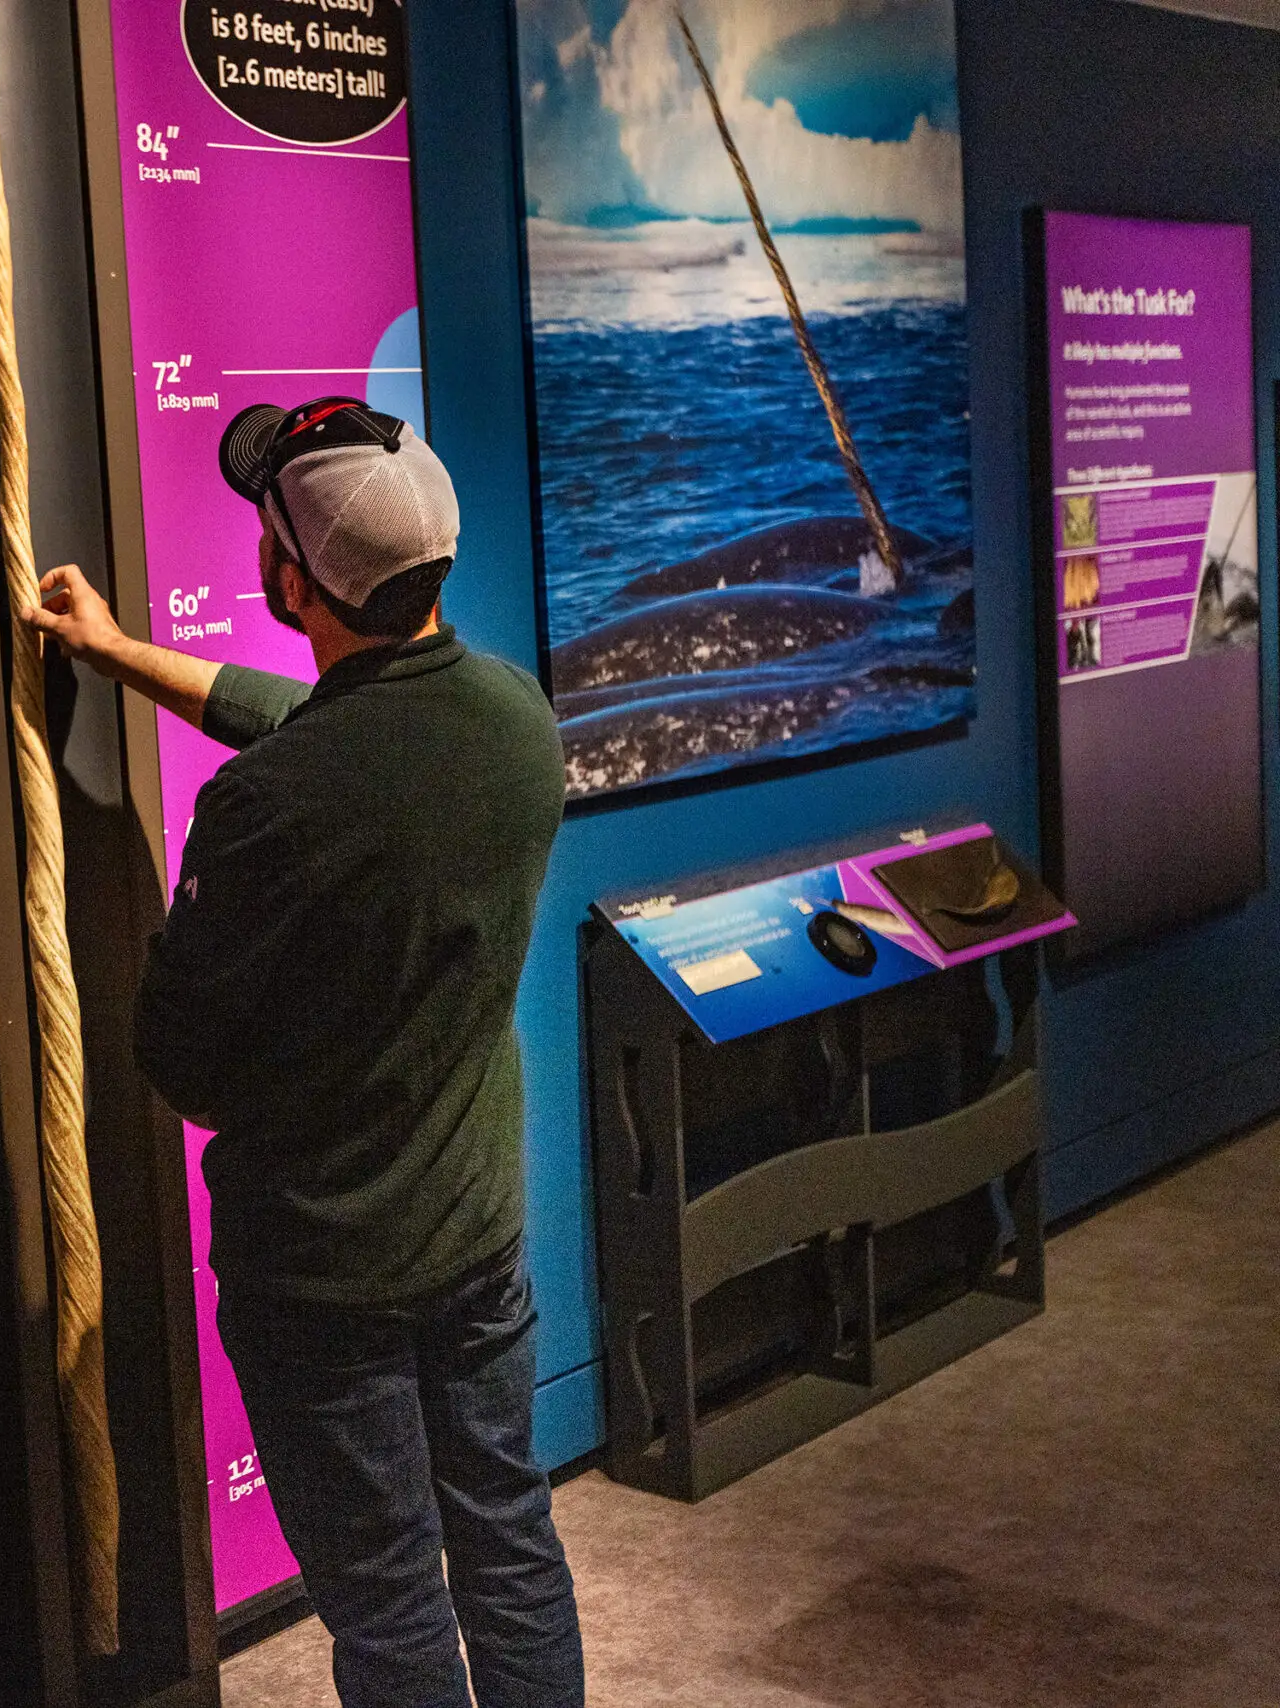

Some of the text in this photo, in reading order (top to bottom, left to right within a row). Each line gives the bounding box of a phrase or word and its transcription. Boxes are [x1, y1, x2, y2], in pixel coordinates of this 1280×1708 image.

[211, 8, 387, 57] is 8 feet, 6 inches
[218, 55, 386, 99] [2.6 meters] tall!
[136, 123, 180, 161] 84"
[139, 164, 201, 184] [2134 mm]
[152, 354, 192, 391] 72"
[157, 392, 219, 411] [1829 mm]
[168, 586, 209, 618] 60"
[172, 617, 232, 642] [1524 mm]
[228, 1481, 253, 1502] [305
